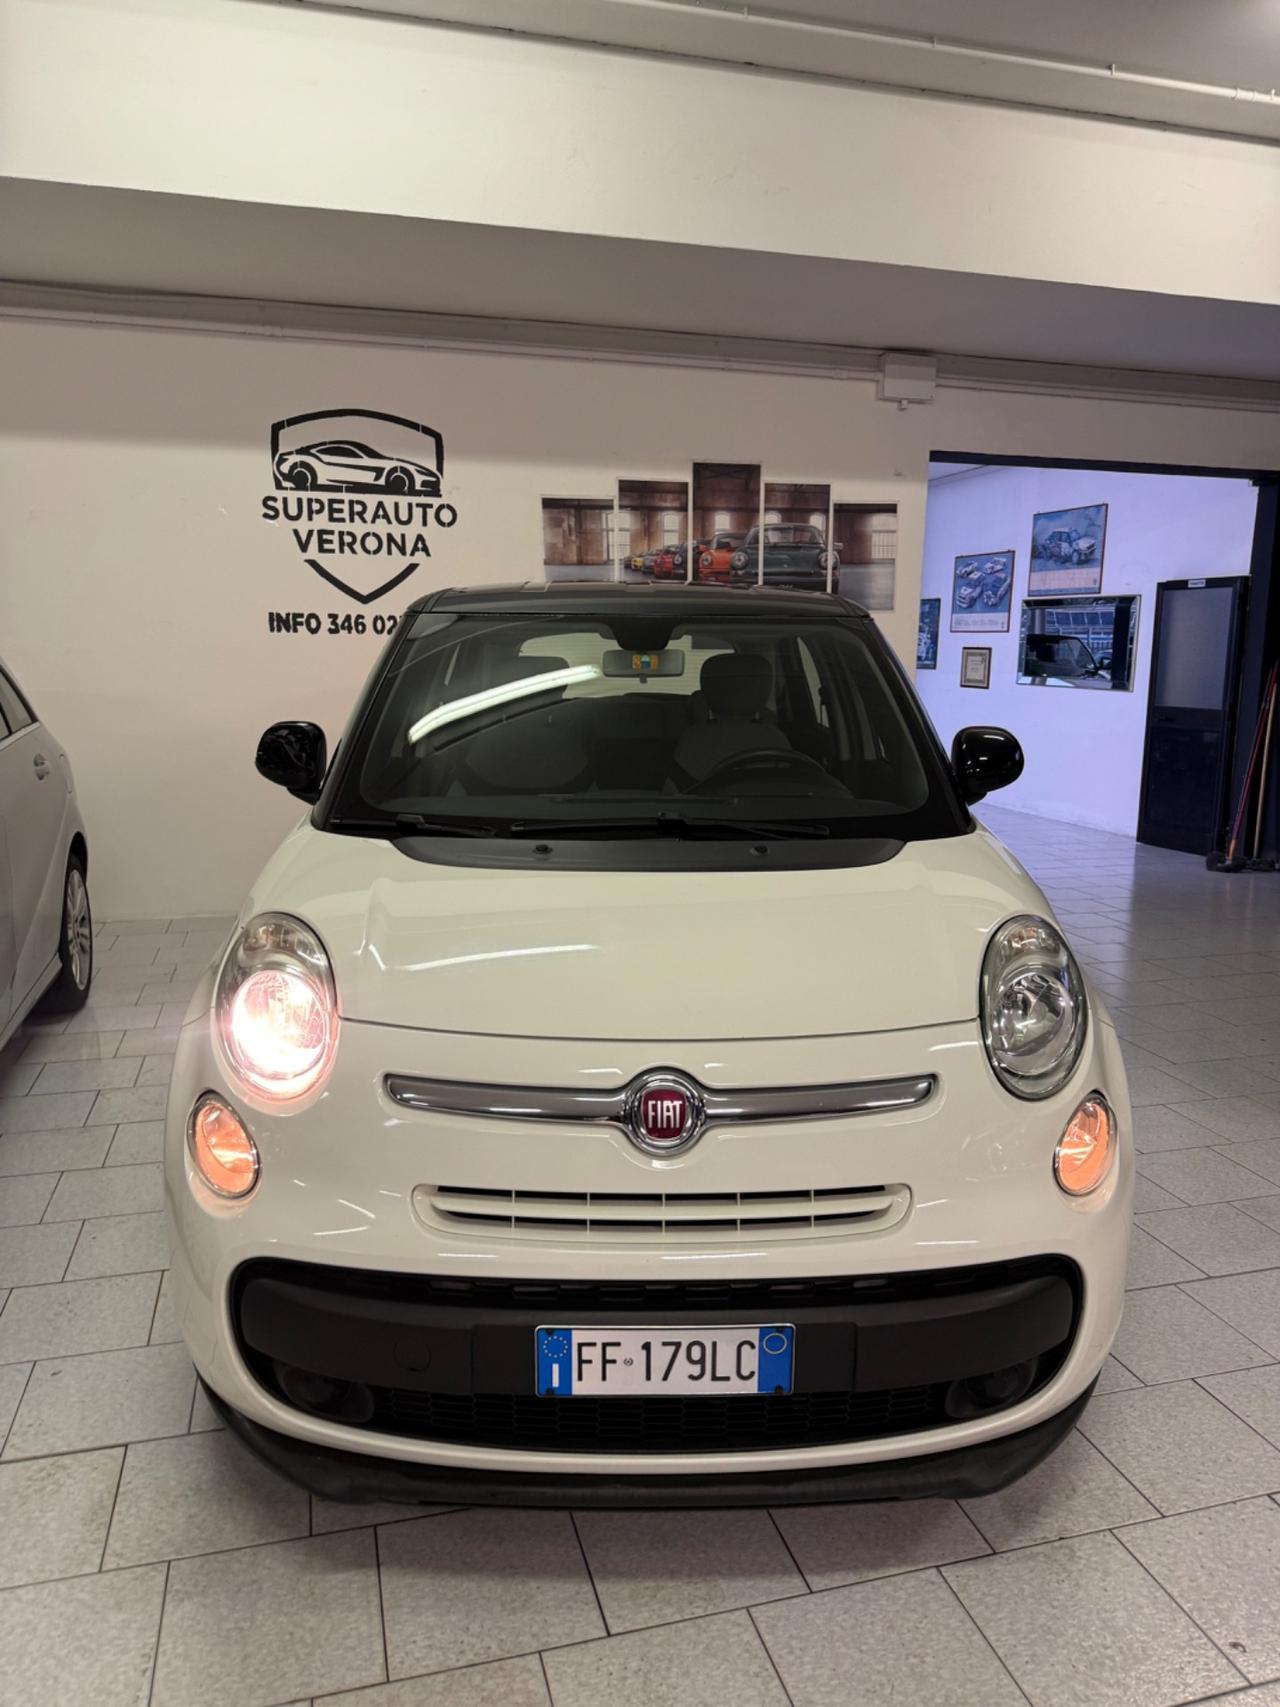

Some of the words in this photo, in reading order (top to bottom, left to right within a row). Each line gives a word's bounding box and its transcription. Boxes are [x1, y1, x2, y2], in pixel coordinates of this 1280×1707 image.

[262, 495, 458, 528] SUPERAUTO
[292, 528, 431, 557] VERONA
[268, 612, 321, 635] INFO
[327, 613, 366, 635] 346
[373, 614, 402, 636] 02
[647, 1100, 683, 1128] FIAT
[552, 1363, 559, 1387] I
[576, 1341, 622, 1382] FF
[640, 1340, 757, 1382] 179LC
